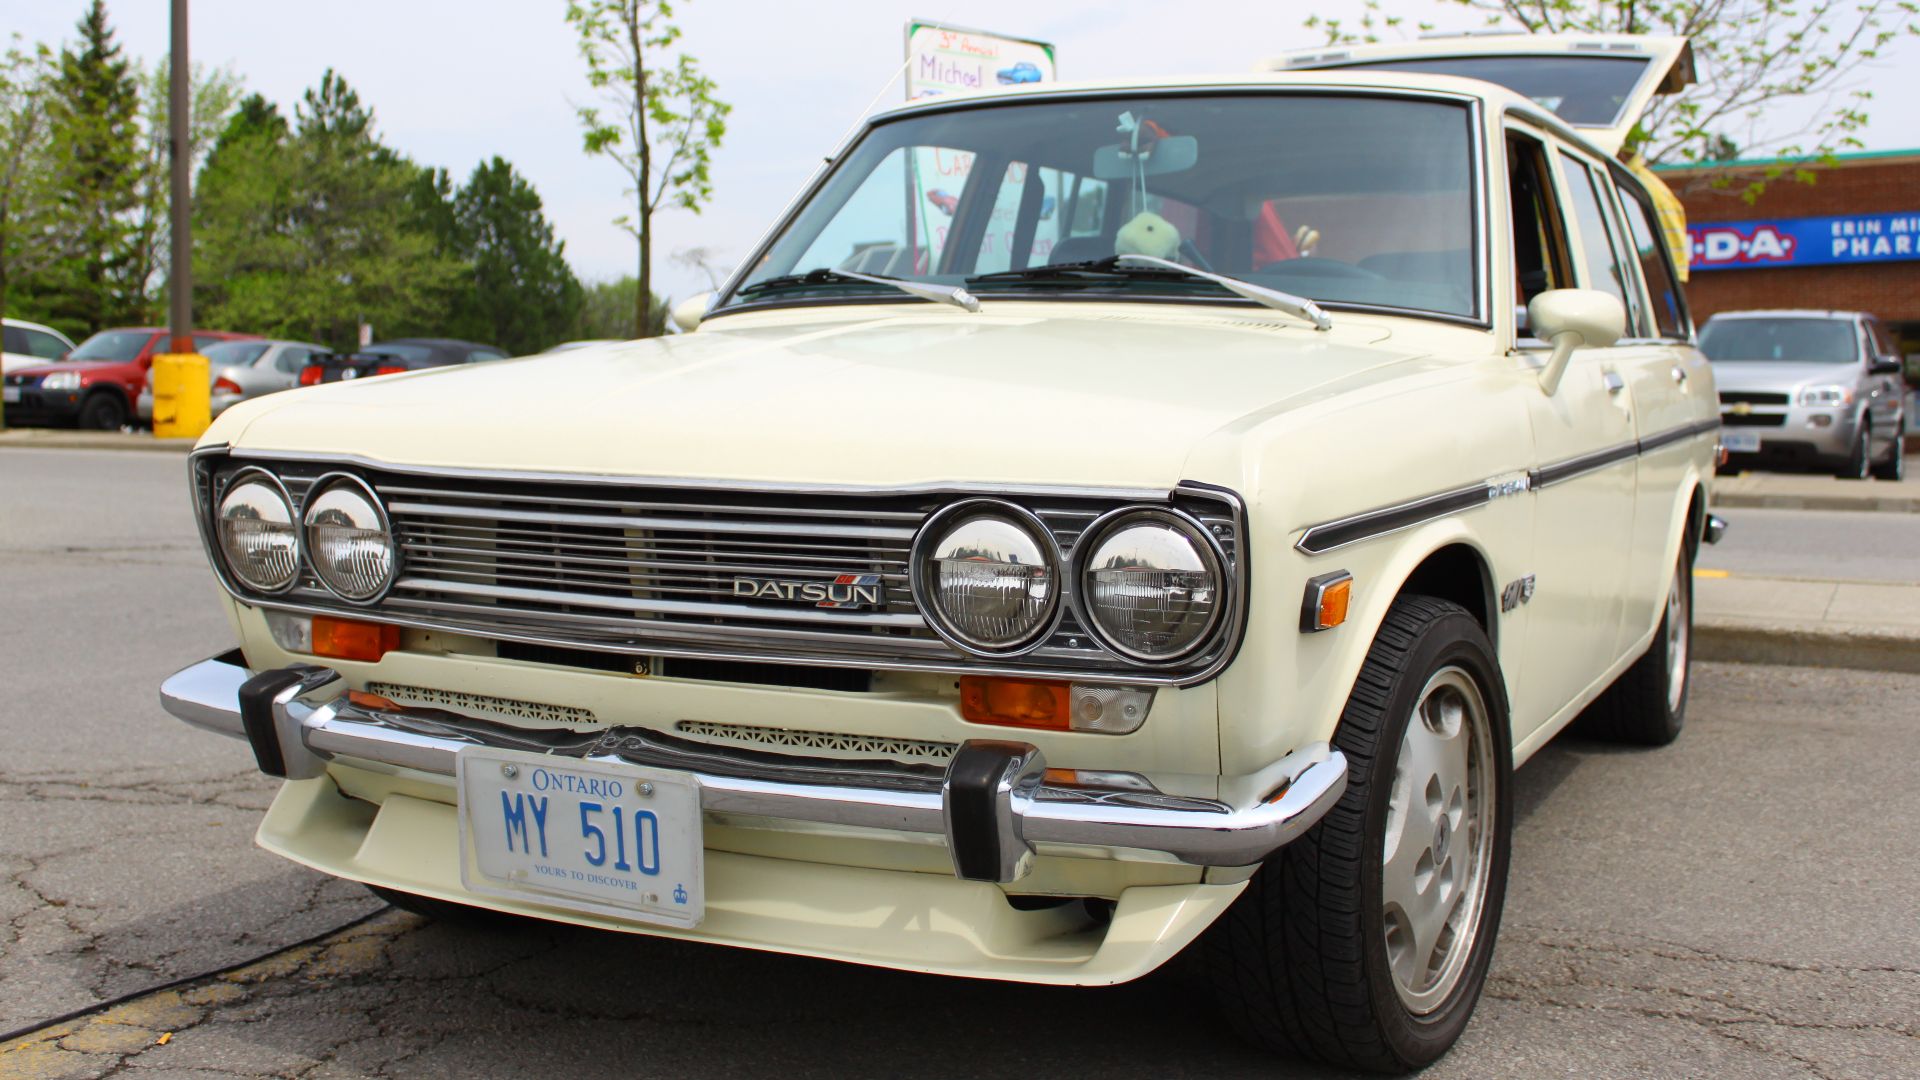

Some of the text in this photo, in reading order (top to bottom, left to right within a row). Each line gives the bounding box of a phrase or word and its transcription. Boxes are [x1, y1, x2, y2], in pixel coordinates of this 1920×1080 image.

[1831, 220, 1881, 237] ERIN
[1832, 233, 1920, 257] PHAR
[734, 578, 877, 604] DATSUN
[501, 790, 660, 876] MY 510
[534, 864, 638, 891] YOURS TO DISCOVER
